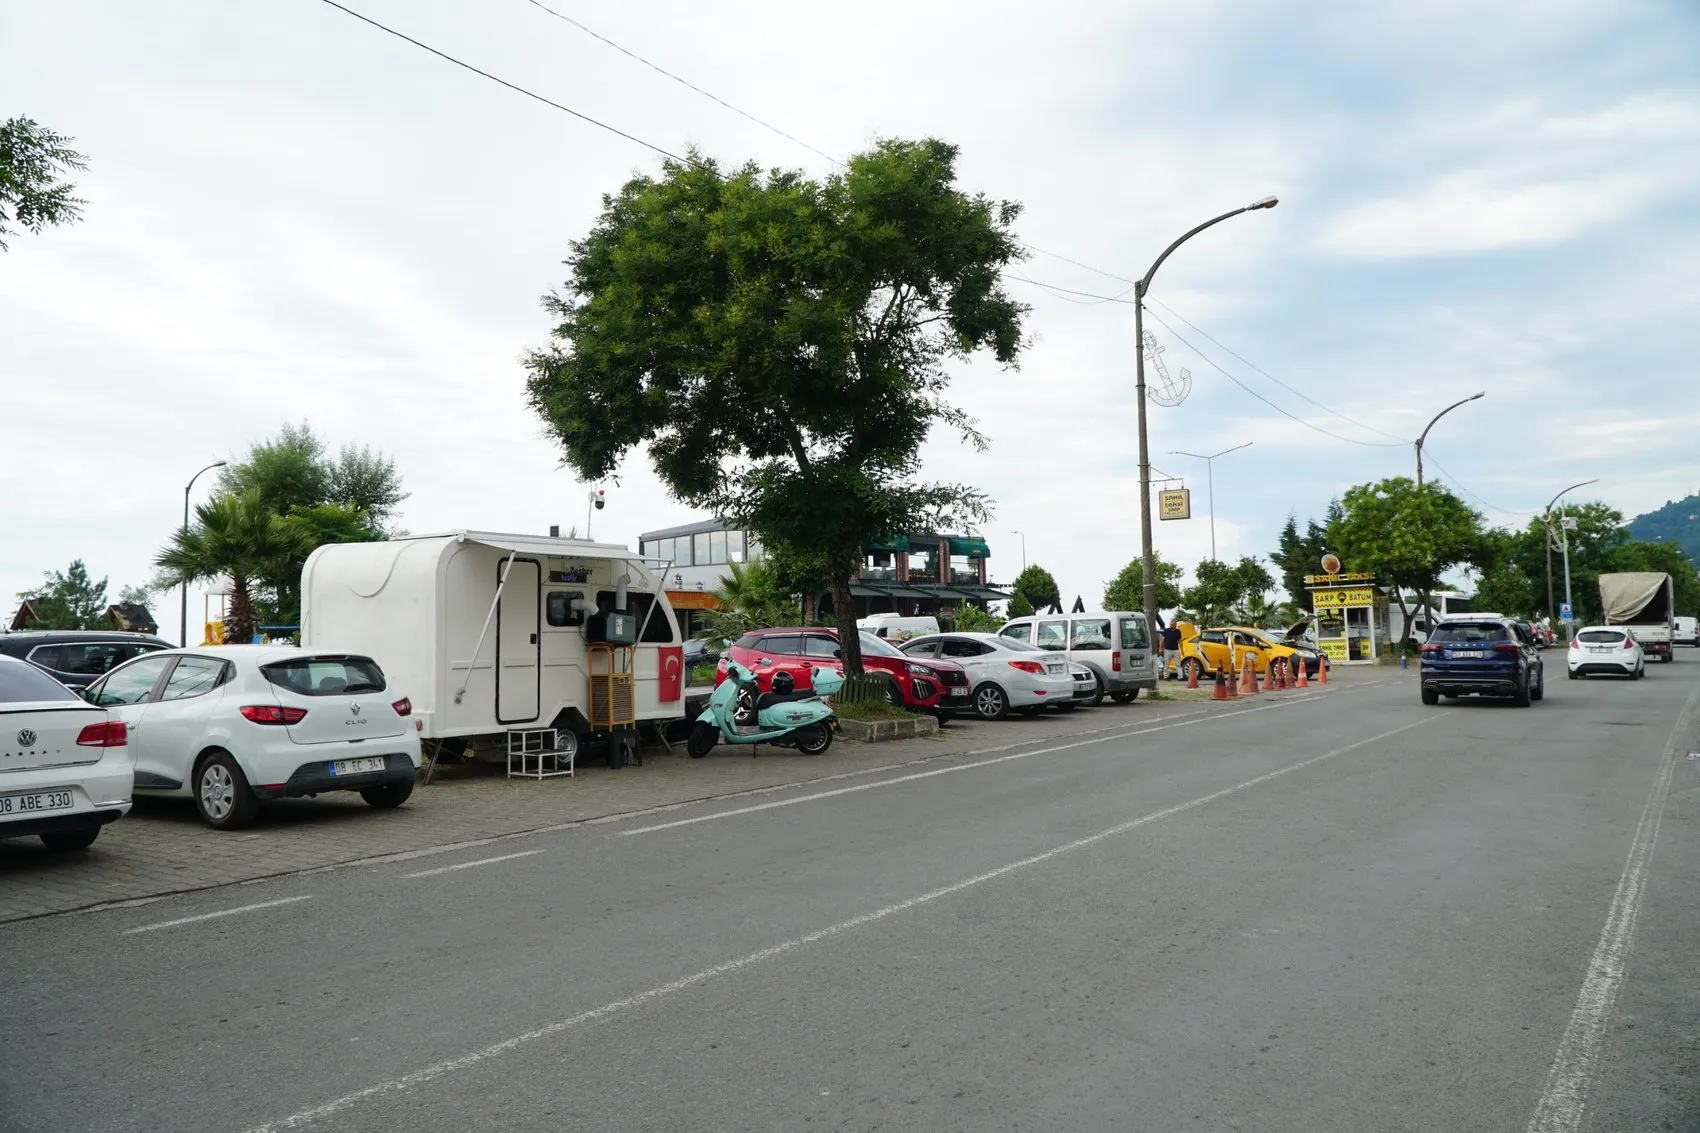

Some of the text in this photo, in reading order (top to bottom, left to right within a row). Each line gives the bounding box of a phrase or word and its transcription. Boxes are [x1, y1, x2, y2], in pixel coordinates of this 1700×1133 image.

[1315, 593, 1372, 603] SARP BATUM
[344, 718, 368, 726] CLIO
[335, 758, 382, 774] 08 EC 341
[20, 795, 42, 811] ABE
[48, 792, 70, 808] 330
